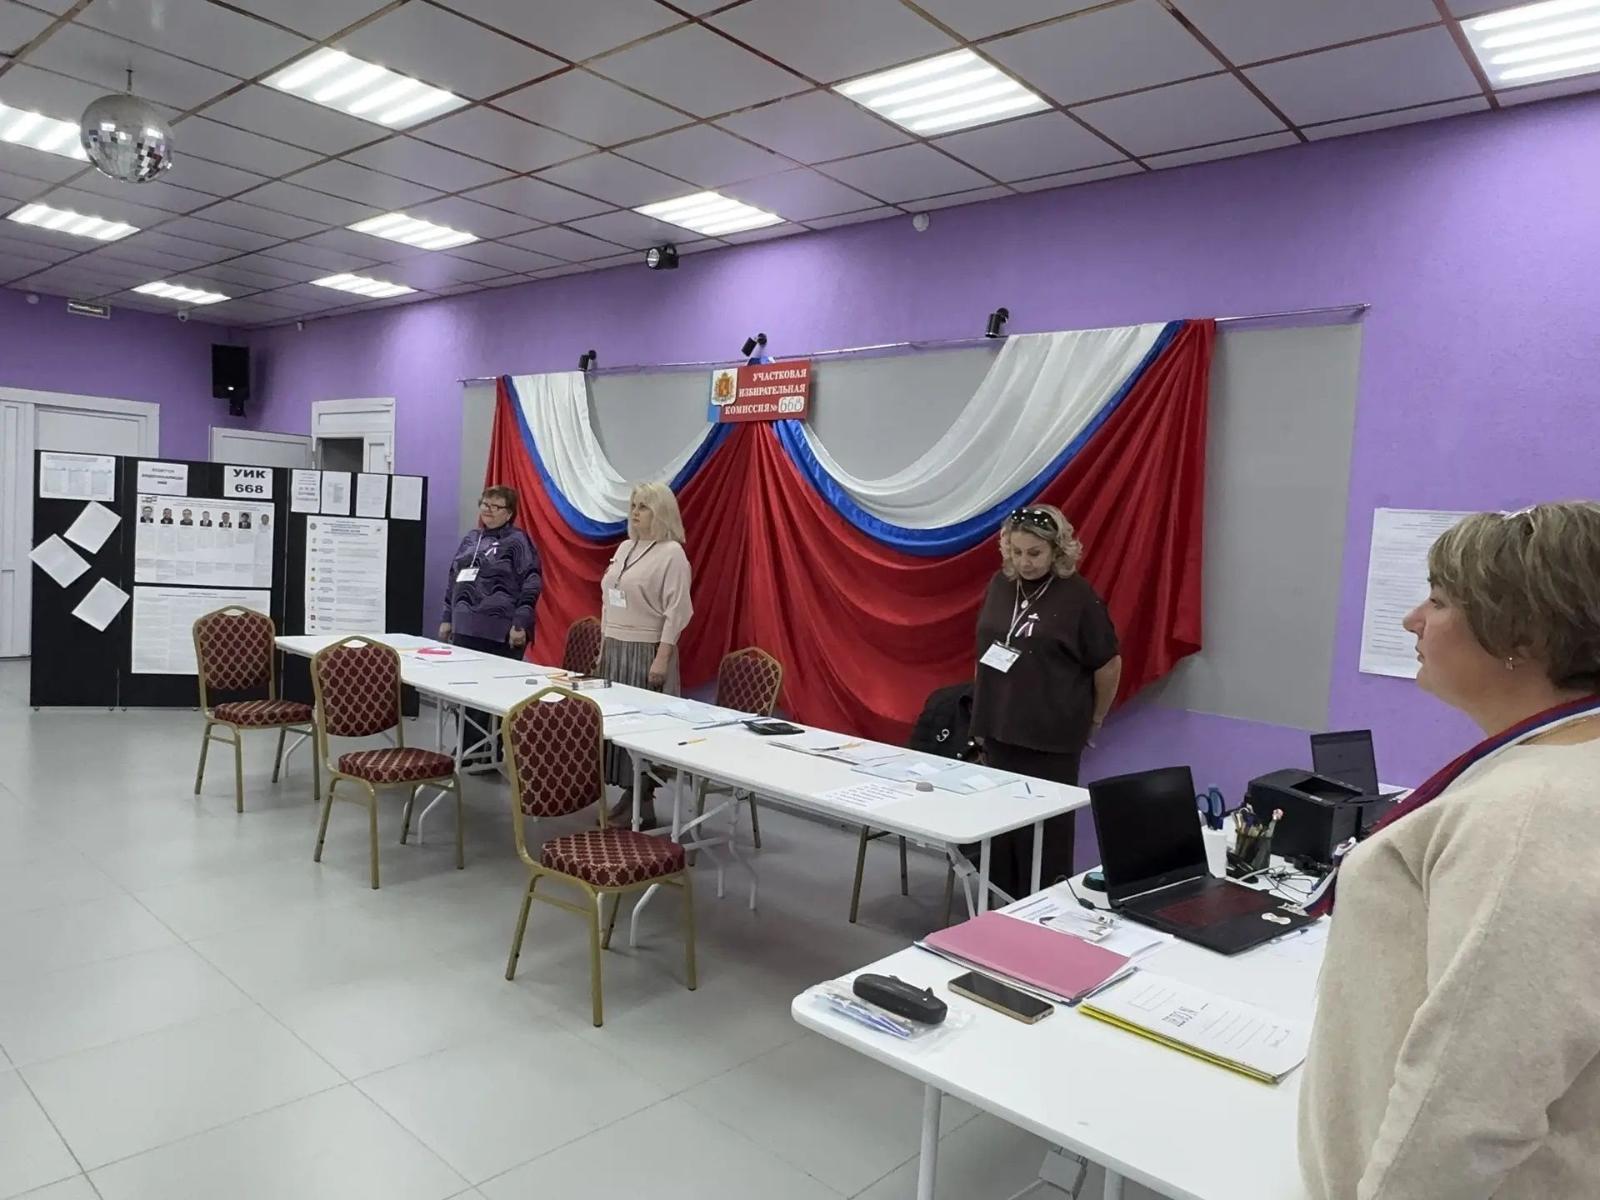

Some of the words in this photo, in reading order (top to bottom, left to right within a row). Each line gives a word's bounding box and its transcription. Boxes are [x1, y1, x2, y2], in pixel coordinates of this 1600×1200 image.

[753, 369, 807, 381] УЧАСТКОВАЯ
[739, 384, 805, 397] ИЗБИРАТЕЛЬНАЯ
[725, 403, 770, 415] КОМИССИЯ
[233, 468, 266, 479] УИК
[234, 483, 264, 493] 668
